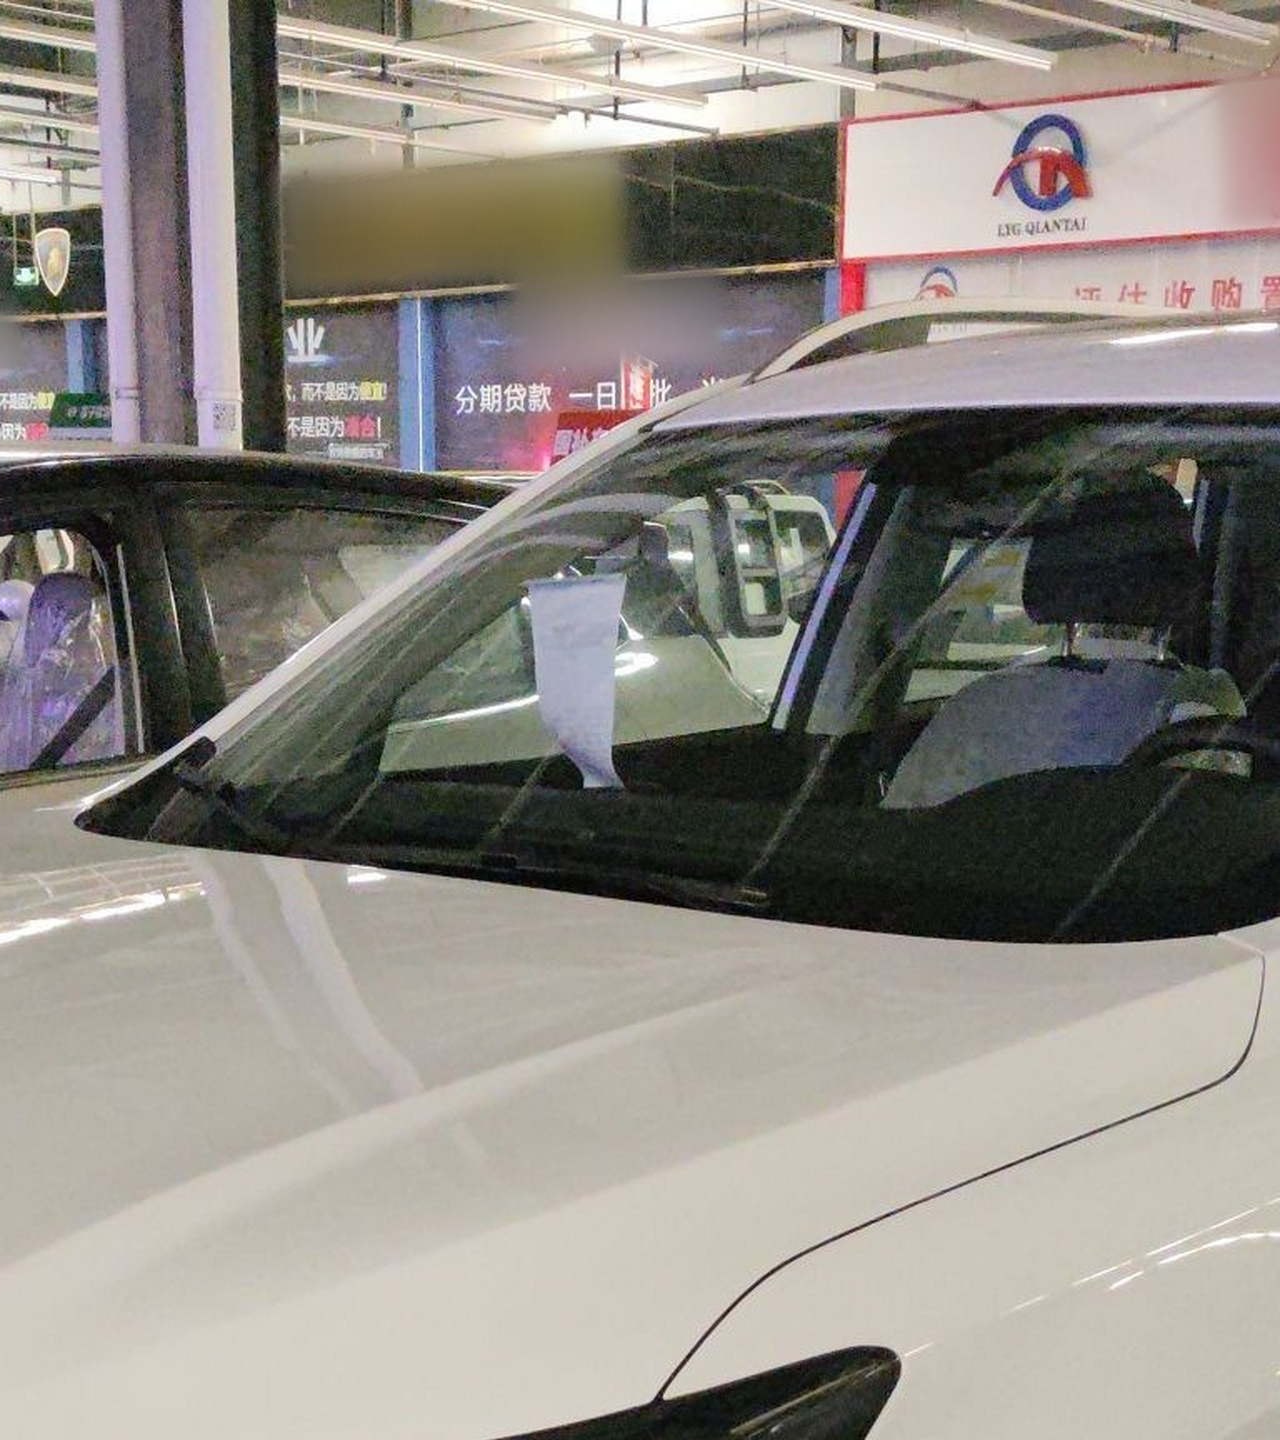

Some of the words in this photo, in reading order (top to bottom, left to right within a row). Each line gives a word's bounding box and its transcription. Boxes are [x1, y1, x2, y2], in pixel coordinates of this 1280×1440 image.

[997, 223, 1020, 237] LYG
[455, 382, 552, 415] 分期贷款
